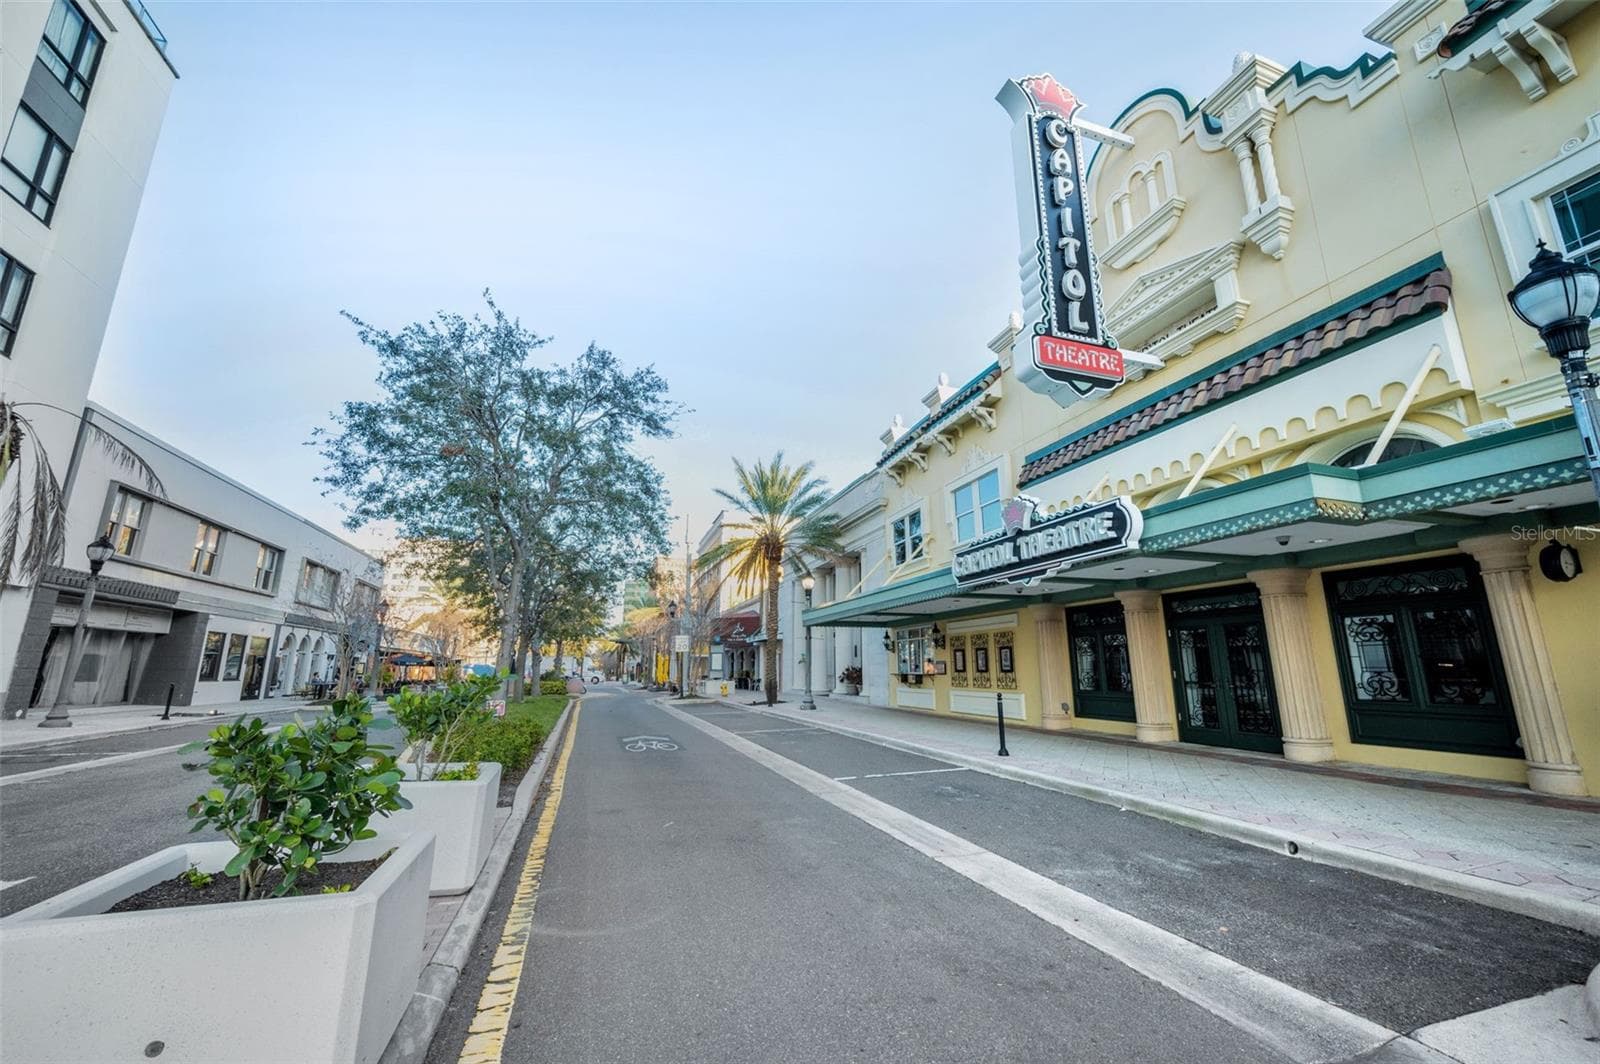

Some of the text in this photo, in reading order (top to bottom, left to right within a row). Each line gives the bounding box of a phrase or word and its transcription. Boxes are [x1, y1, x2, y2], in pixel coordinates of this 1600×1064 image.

[1045, 118, 1089, 334] CAPITOL
[1043, 341, 1121, 372] THEATRE
[954, 511, 1117, 577] CAPITOL THEATRE
